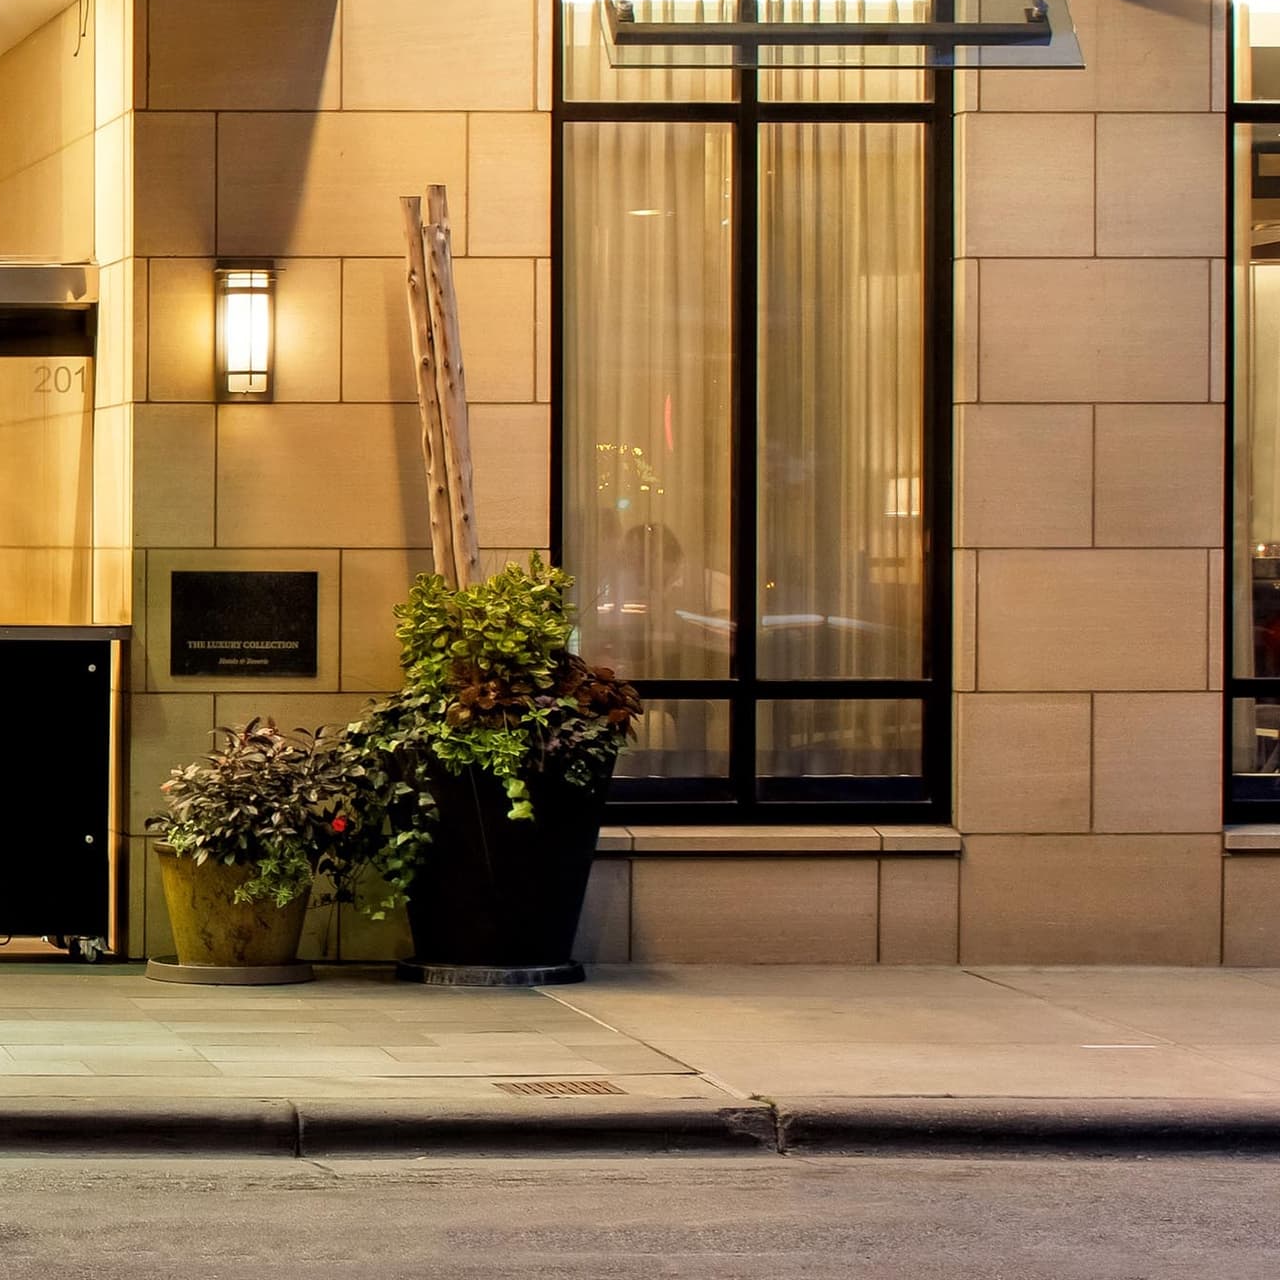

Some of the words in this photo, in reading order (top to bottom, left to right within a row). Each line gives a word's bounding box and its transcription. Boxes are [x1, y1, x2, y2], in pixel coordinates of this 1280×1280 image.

[33, 365, 86, 393] 201
[186, 640, 205, 649] THE
[206, 640, 242, 649] LUXURY
[243, 640, 299, 649] COLLECTION
